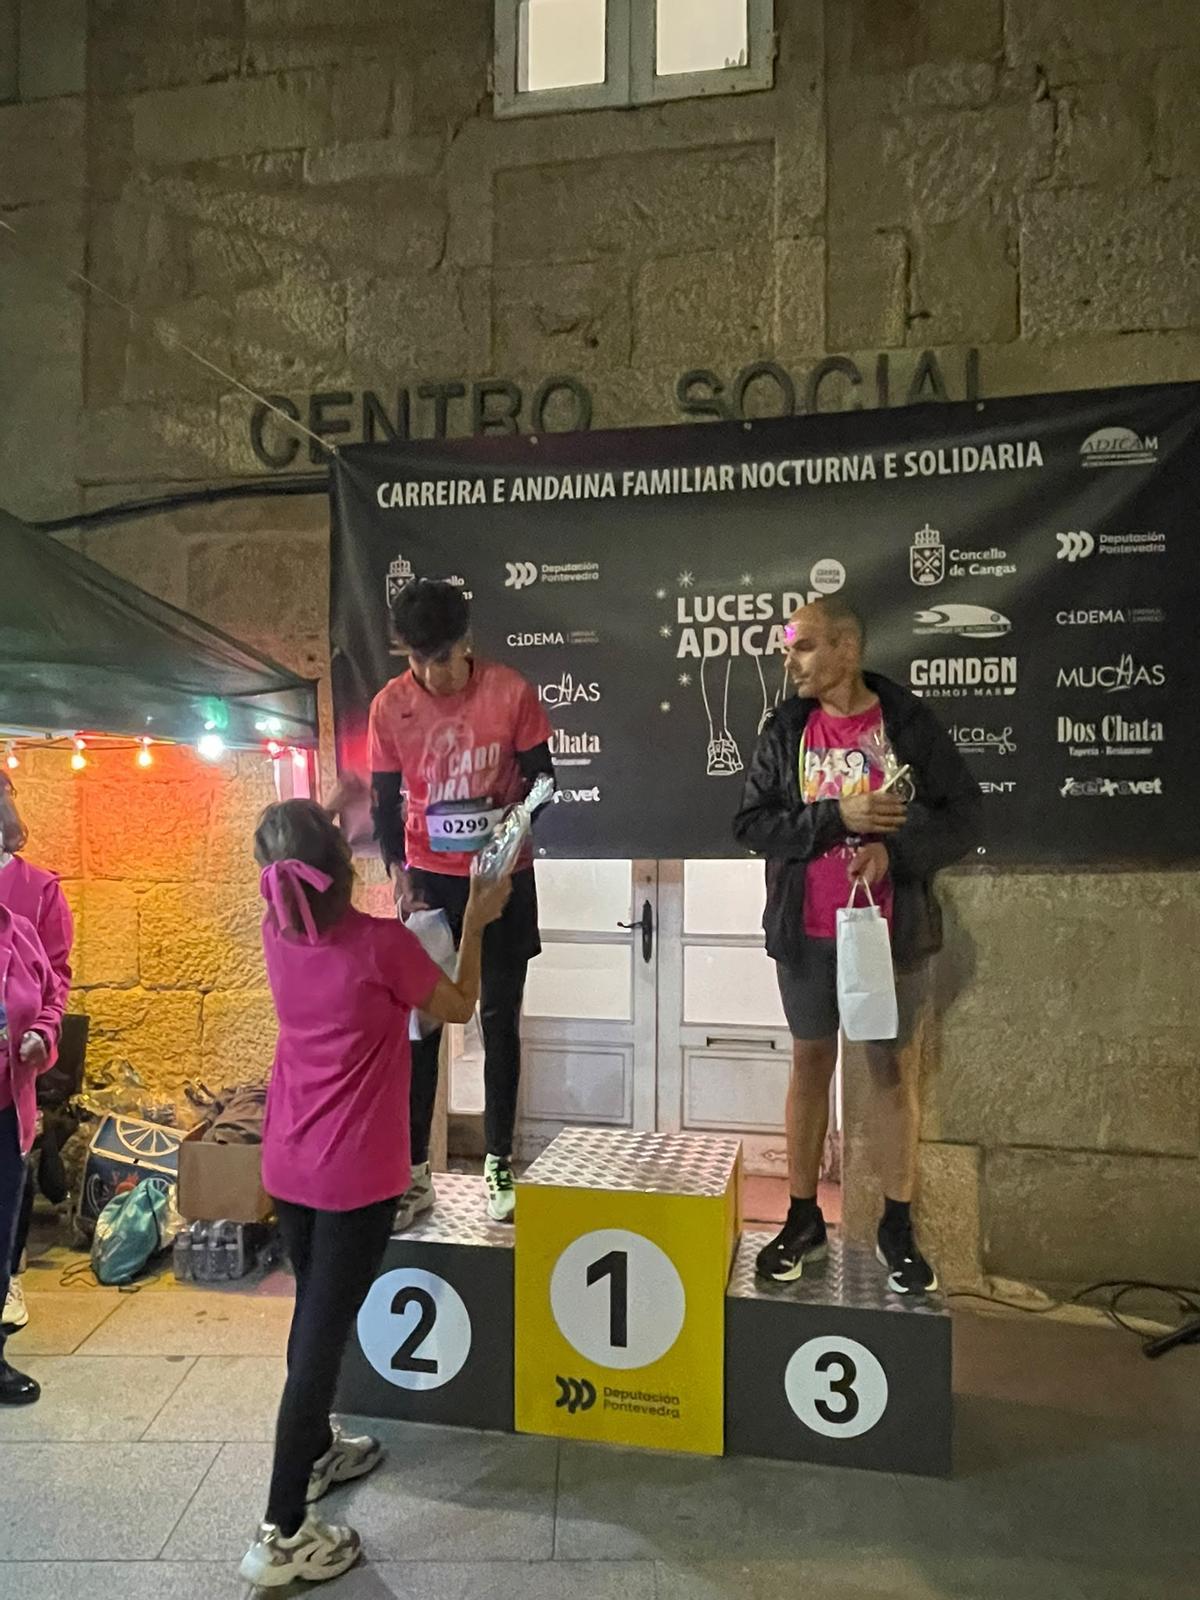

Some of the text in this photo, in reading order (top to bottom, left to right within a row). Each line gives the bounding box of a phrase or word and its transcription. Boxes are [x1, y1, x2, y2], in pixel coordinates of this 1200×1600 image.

[376, 440, 1045, 510] CARREIRA E ANDAINA FAMILIAR NOCTURNA E SOLIDARIA
[949, 548, 1007, 561] Concello
[949, 562, 1017, 577] de Cangas
[676, 591, 824, 624] LUCES D
[676, 623, 788, 659] ADICA
[1056, 653, 1166, 693] MUCHAS
[538, 672, 601, 710] CHAS
[925, 688, 968, 698] SOMOS
[948, 724, 984, 743] ica
[1057, 714, 1164, 743] Dos Chata
[443, 817, 489, 834] 0299
[585, 1250, 629, 1349] 1
[389, 1286, 439, 1375] 2
[813, 1350, 860, 1425] 3
[603, 1398, 680, 1419] Pontevedra
